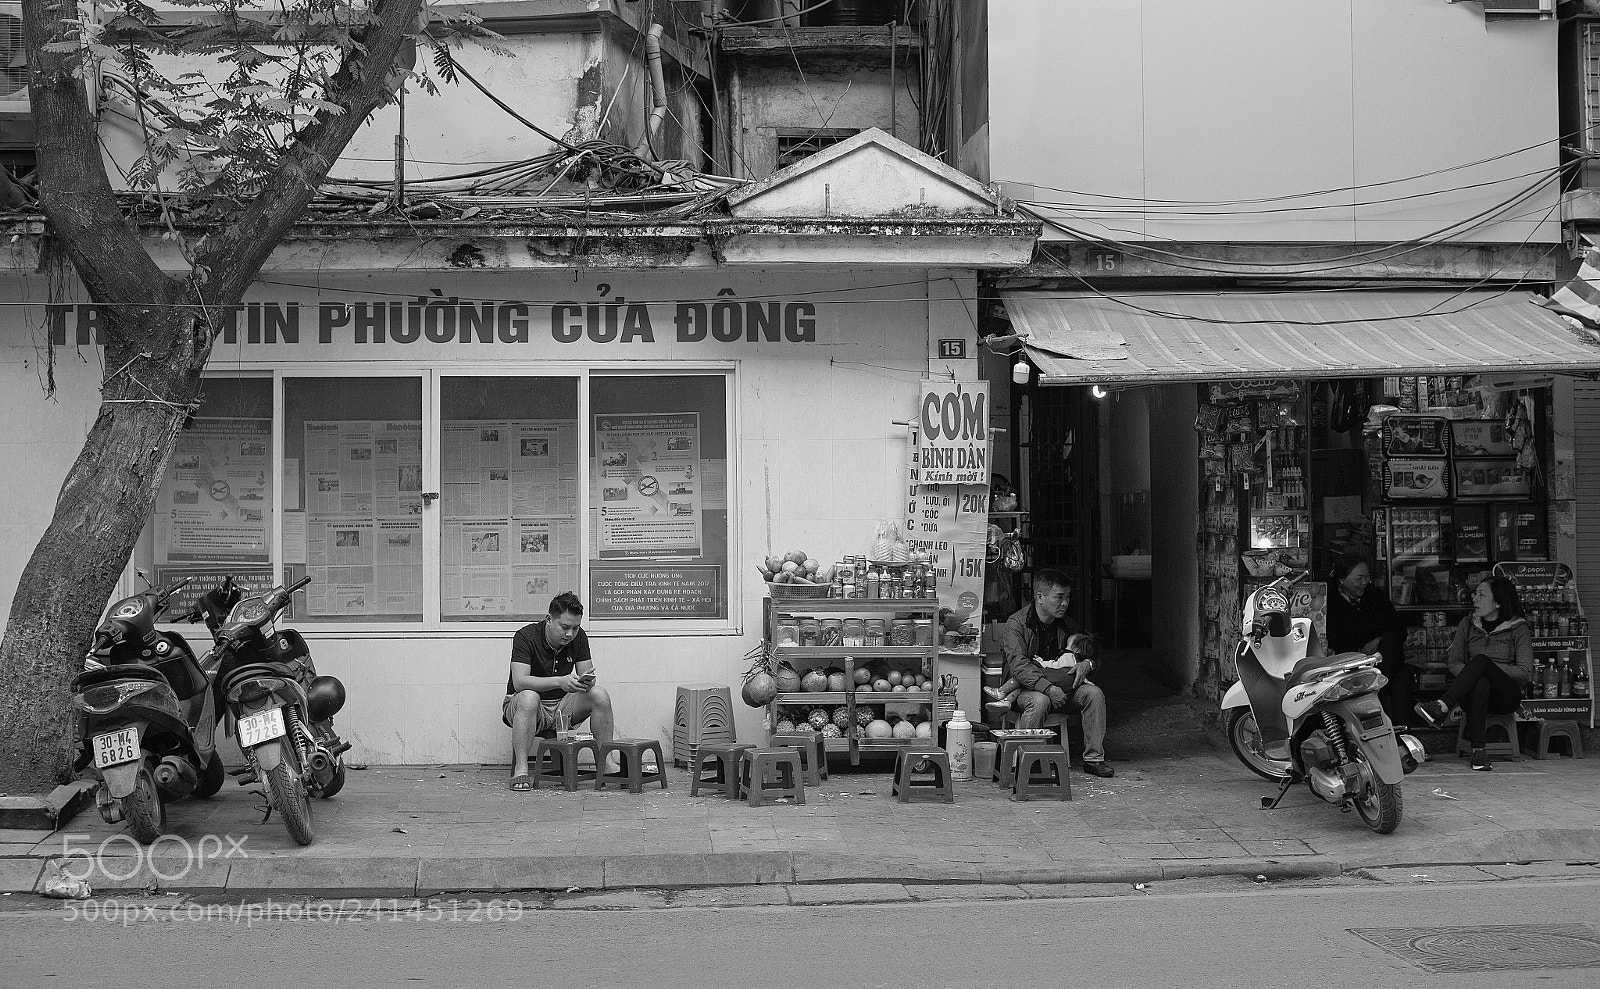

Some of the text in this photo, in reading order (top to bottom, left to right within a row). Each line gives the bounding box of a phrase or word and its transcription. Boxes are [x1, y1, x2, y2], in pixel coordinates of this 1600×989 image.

[1096, 254, 1115, 271] 15
[46, 303, 105, 345] TR
[318, 288, 529, 344] PHƯỜNG
[551, 283, 656, 344] CỬA
[674, 287, 816, 343] ĐÔNG
[942, 342, 961, 356] 15
[922, 383, 985, 441] CƠM
[921, 441, 953, 469] BÌNH
[957, 441, 986, 469] DÂN
[925, 470, 953, 482] Kính
[956, 470, 978, 482] mời
[601, 507, 607, 516] 5
[962, 493, 986, 513] 20K
[935, 541, 948, 551] LEO
[959, 558, 982, 578] 15K
[1527, 566, 1546, 574] pepsi
[246, 723, 280, 744] 7726
[101, 745, 134, 765] 6826
